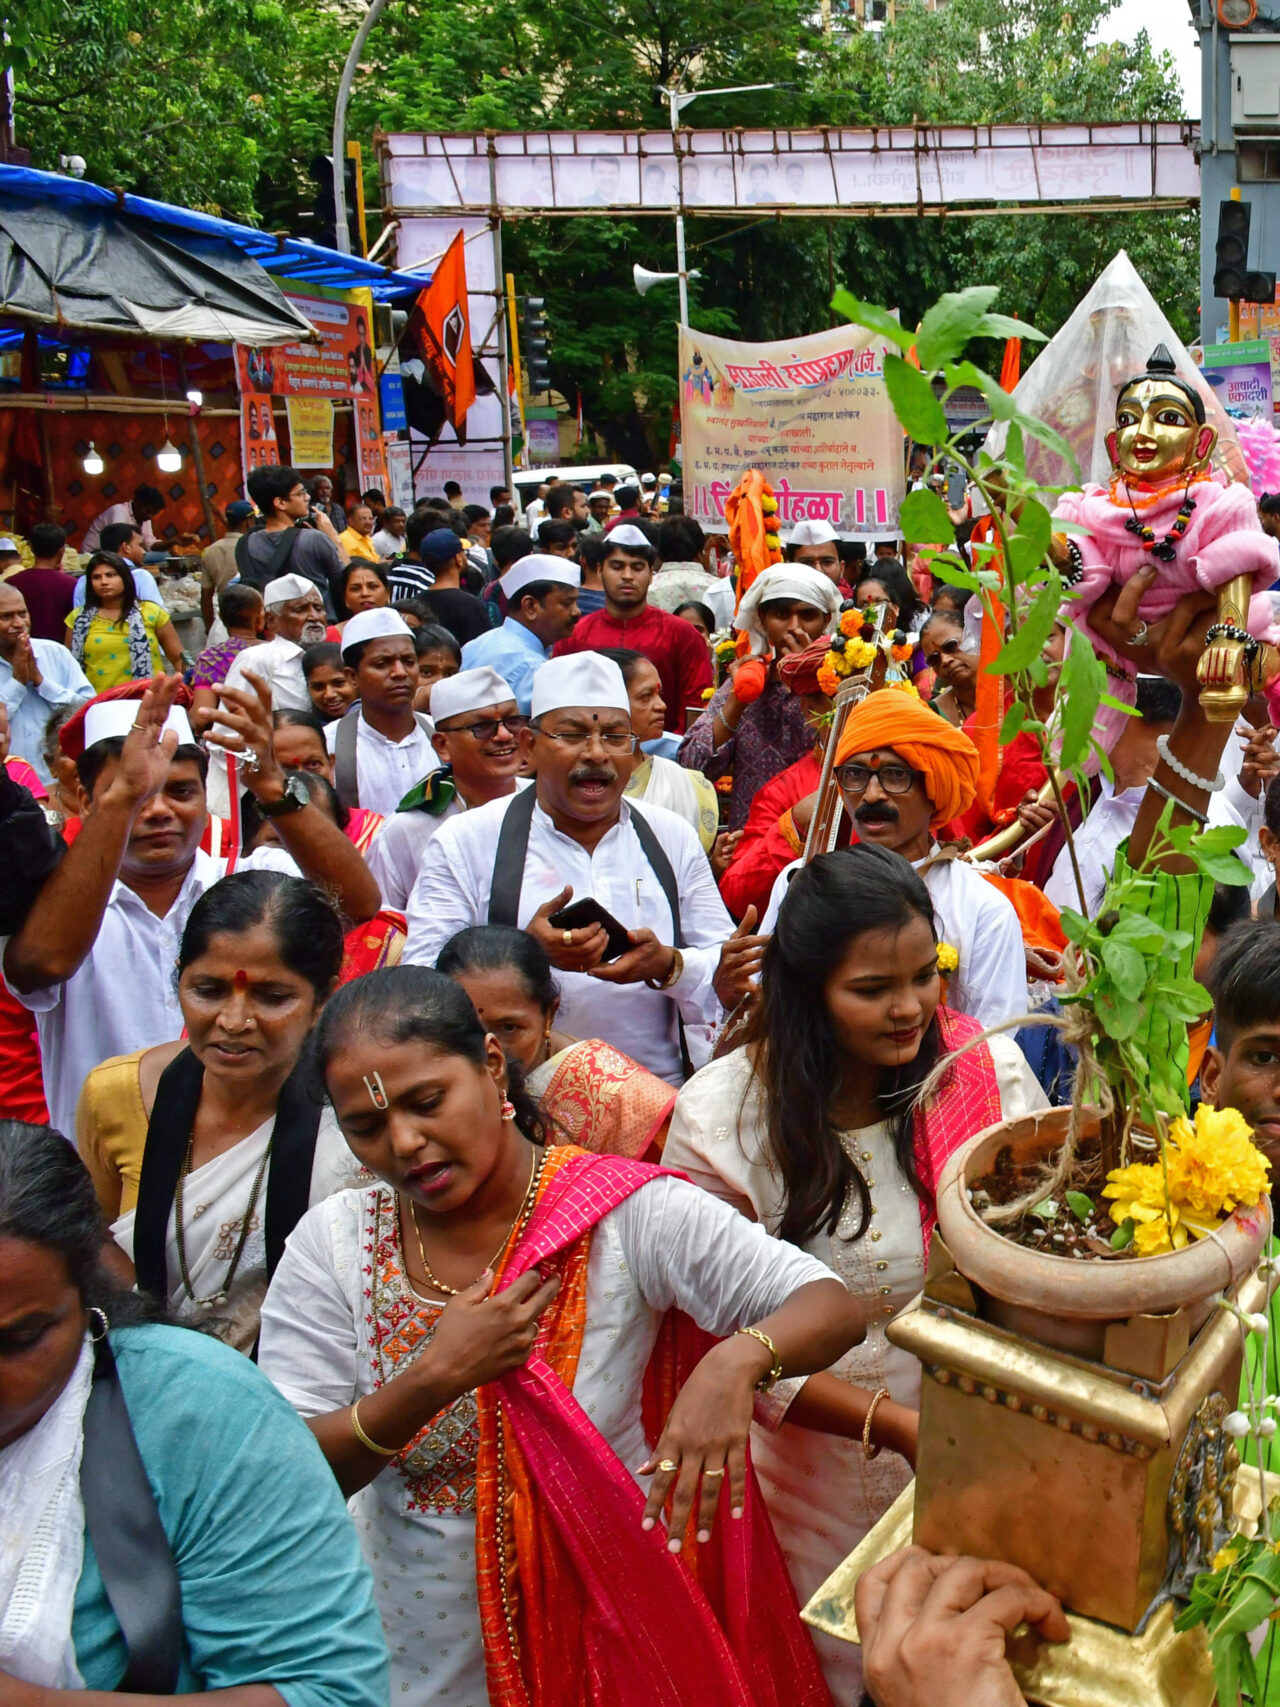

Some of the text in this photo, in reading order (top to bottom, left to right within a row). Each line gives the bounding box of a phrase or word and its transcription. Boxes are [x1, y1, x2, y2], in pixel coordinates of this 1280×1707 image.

[725, 360, 789, 389] माउली
[1227, 377, 1260, 392] आषाढी
[1228, 387, 1268, 403] एकादशी
